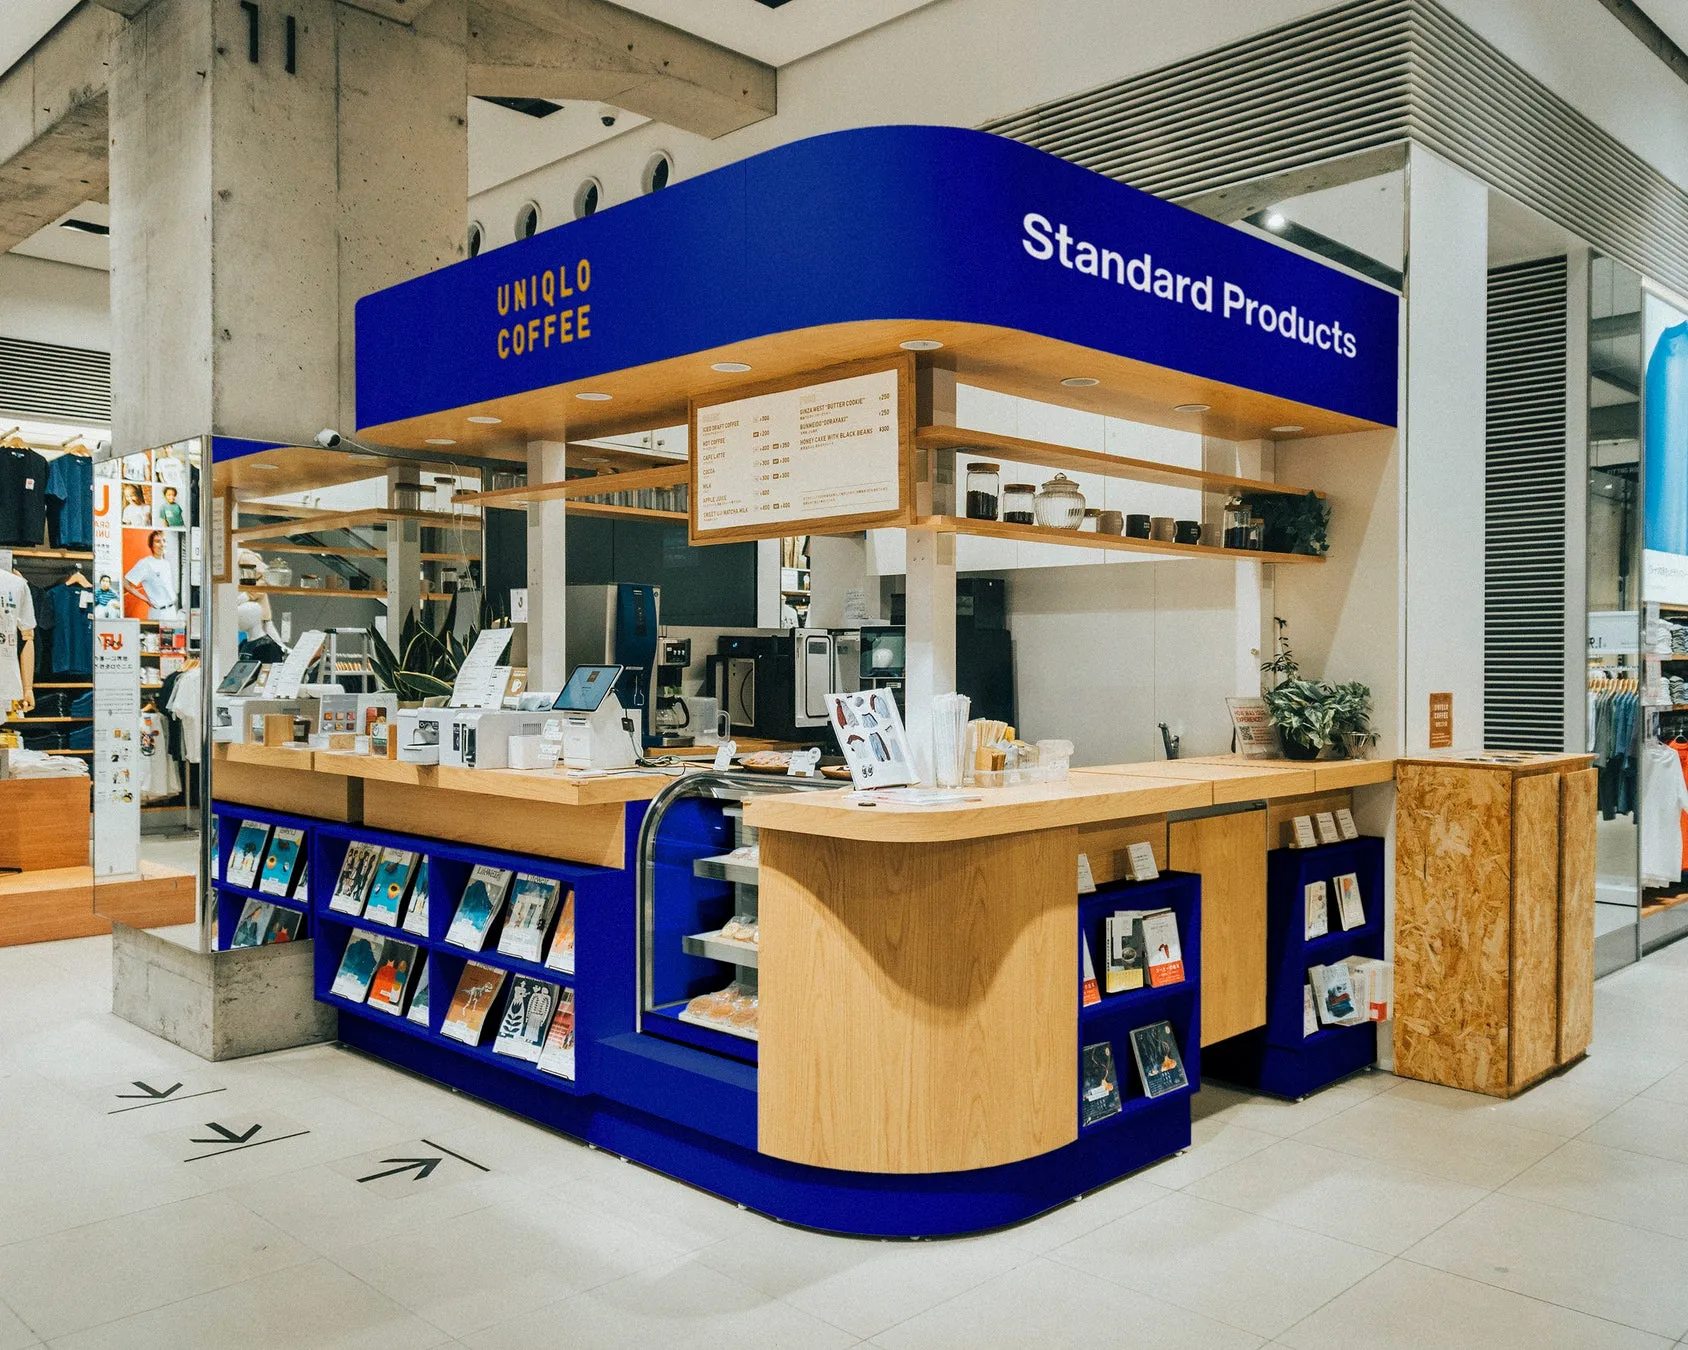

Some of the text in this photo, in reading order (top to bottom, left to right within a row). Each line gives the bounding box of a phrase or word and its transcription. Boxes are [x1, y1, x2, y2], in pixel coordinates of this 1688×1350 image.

[497, 258, 591, 316] UNIQLO
[1022, 212, 1357, 359] Standard Products
[497, 304, 591, 359] COFFEE
[840, 430, 856, 439] BLACK
[856, 428, 873, 437] BEANS
